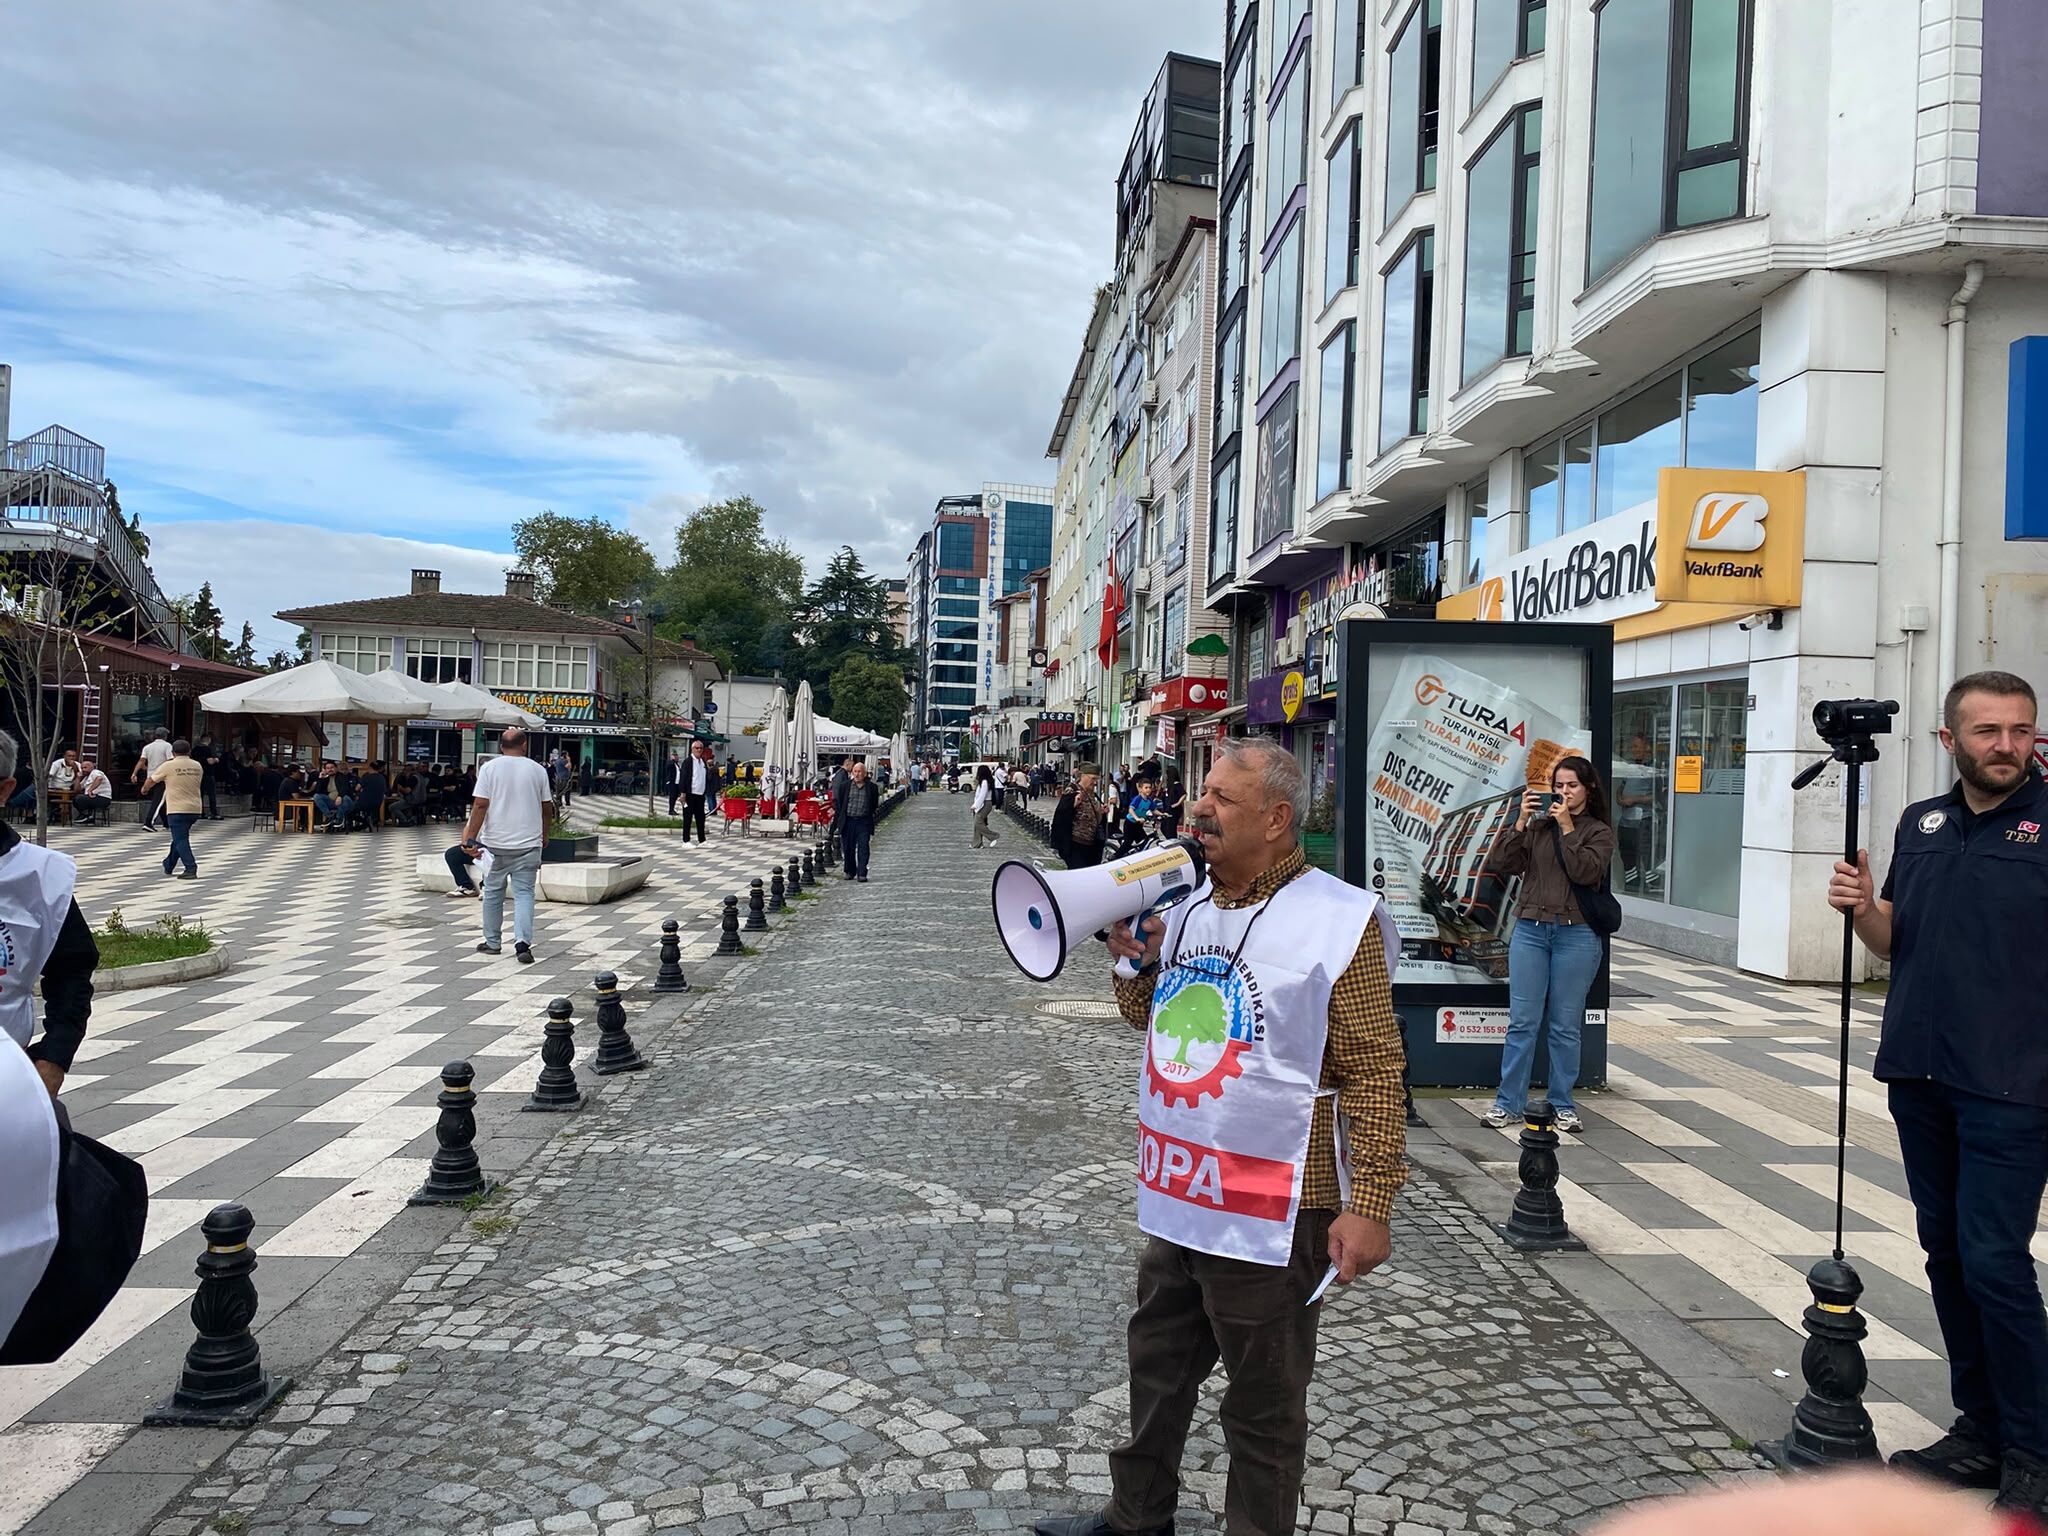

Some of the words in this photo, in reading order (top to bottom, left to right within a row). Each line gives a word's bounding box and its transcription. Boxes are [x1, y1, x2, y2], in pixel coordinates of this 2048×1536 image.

[1511, 520, 1656, 621] VakıfBank
[1684, 560, 1764, 579] VakıfBank
[1358, 569, 1388, 605] HOTEL
[986, 623, 993, 641] VE
[557, 697, 590, 707] KEBAP
[1283, 680, 1299, 706] gratis
[1442, 716, 1477, 739] TURAN
[1477, 732, 1501, 750] PİSİL
[1448, 692, 1525, 747] TURAA
[816, 735, 848, 743] LEDİYESİ
[1424, 719, 1461, 746] TURAA
[1465, 740, 1509, 766] İNŞAAT
[1383, 751, 1406, 782] DIŞ
[1404, 765, 1454, 805] CEPHE
[1372, 774, 1441, 825] MANTOLAMA
[2005, 829, 2040, 843] TEM
[1235, 957, 1265, 1042] SENDİKASI
[1497, 1026, 1507, 1034] 90
[1162, 1061, 1191, 1078] 2017
